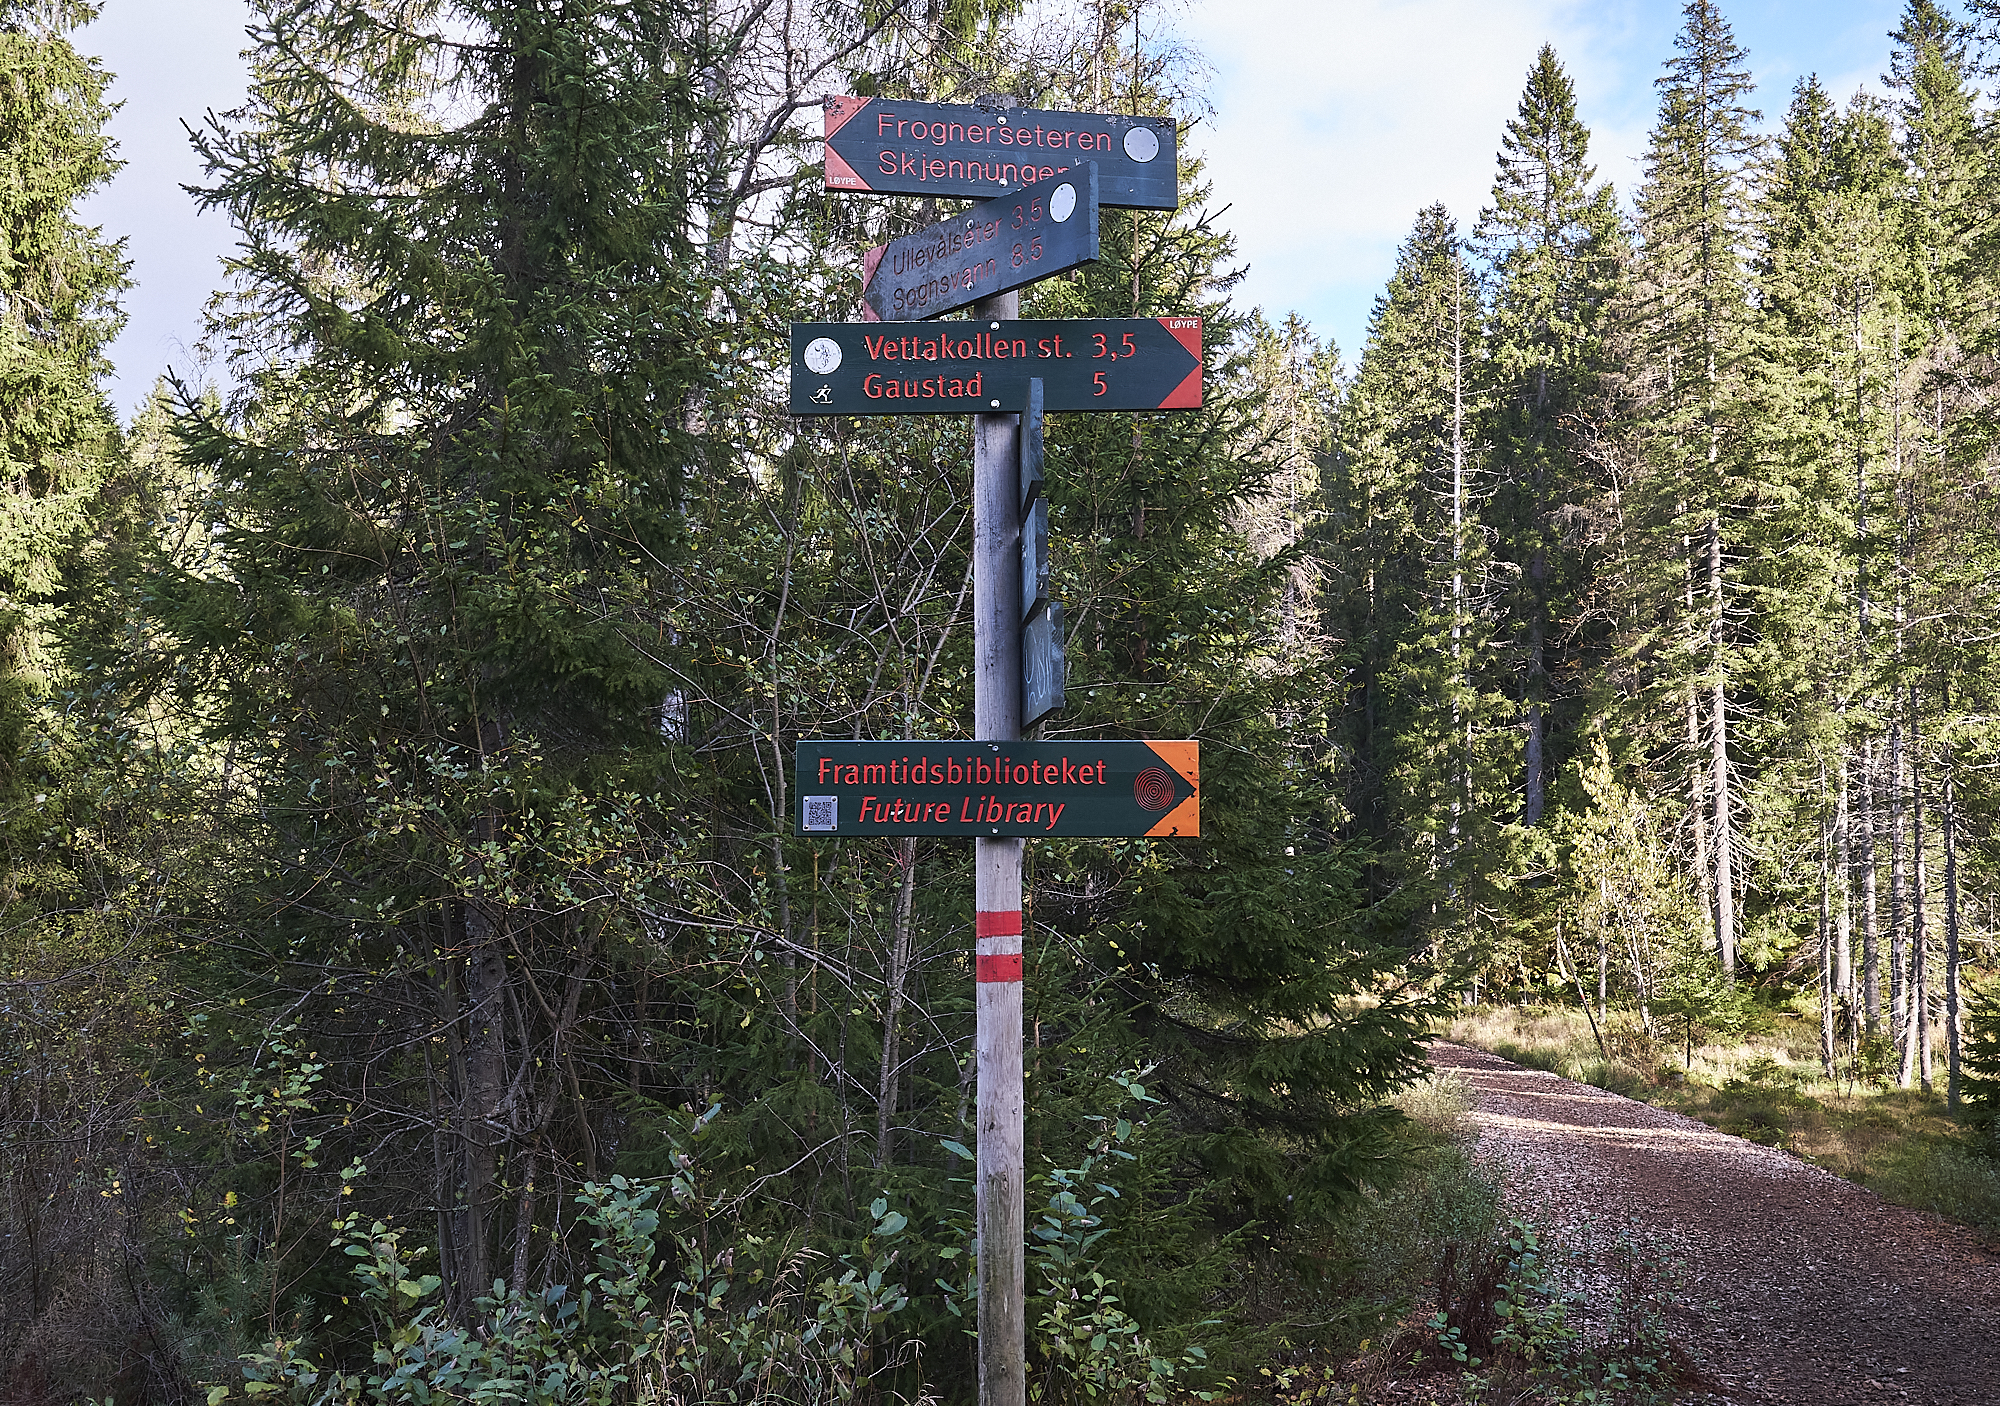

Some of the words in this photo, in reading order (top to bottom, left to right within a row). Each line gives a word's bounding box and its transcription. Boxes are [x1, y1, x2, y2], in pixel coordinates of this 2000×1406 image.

[877, 113, 1112, 151] Frognerseteren
[829, 176, 857, 186] LØYPE
[893, 217, 1003, 276] Ullevålseter
[892, 257, 996, 312] Sognsvann
[1169, 319, 1198, 329] LØYPE
[864, 332, 1027, 361] Vettakollen
[1038, 335, 1073, 359] st.
[1091, 332, 1137, 363] 3,5
[863, 370, 983, 399] Gaustad
[1093, 371, 1108, 397] 5
[817, 756, 1107, 786] Framtidsbiblioteket
[858, 796, 951, 824] Future
[959, 795, 1066, 831] Library
